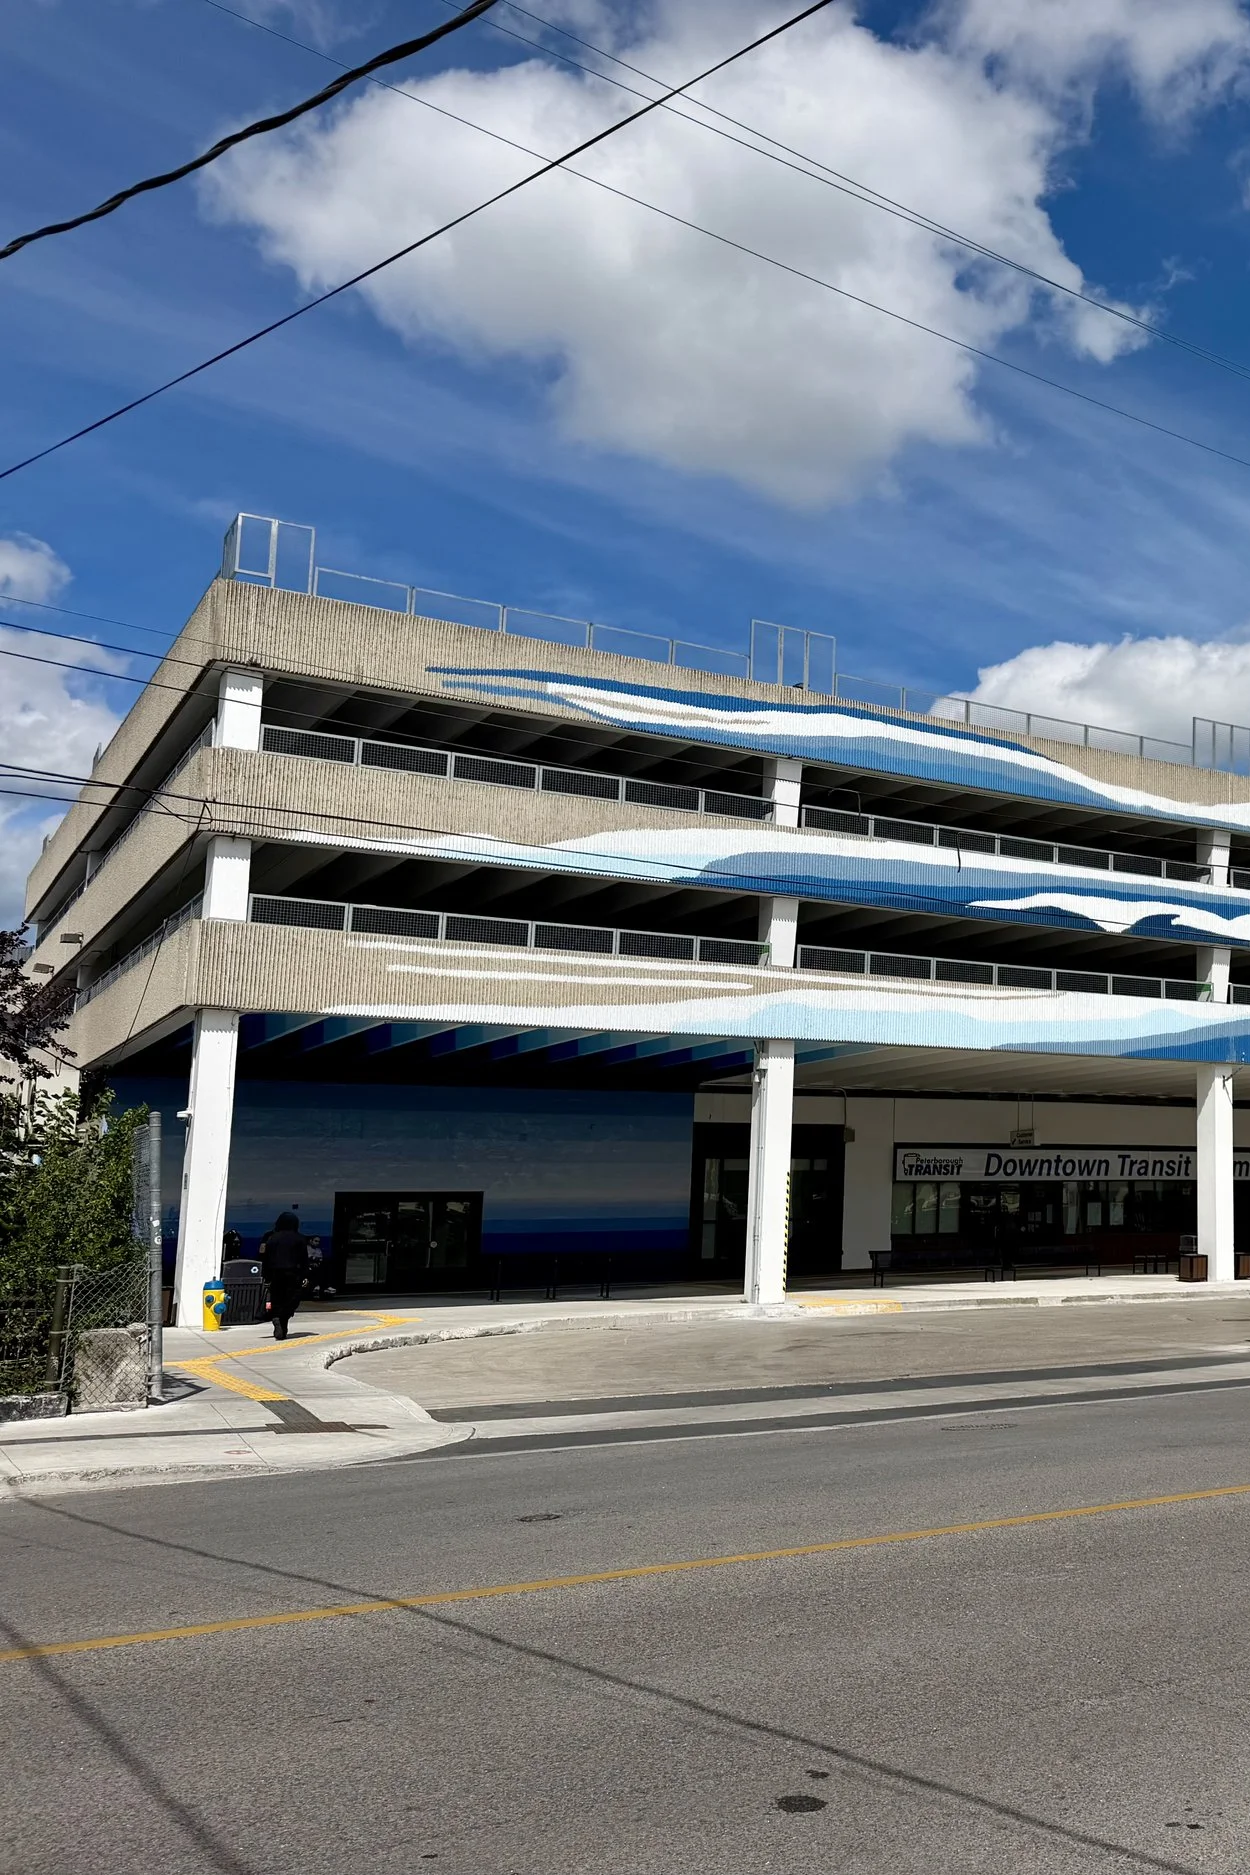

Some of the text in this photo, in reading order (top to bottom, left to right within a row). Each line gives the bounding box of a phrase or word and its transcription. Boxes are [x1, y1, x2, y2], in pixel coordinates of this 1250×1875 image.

[916, 1156, 964, 1166] Peterborough
[984, 1153, 1110, 1177] Downtown
[1117, 1154, 1192, 1177] Transit
[908, 1164, 963, 1176] TRANSIT
